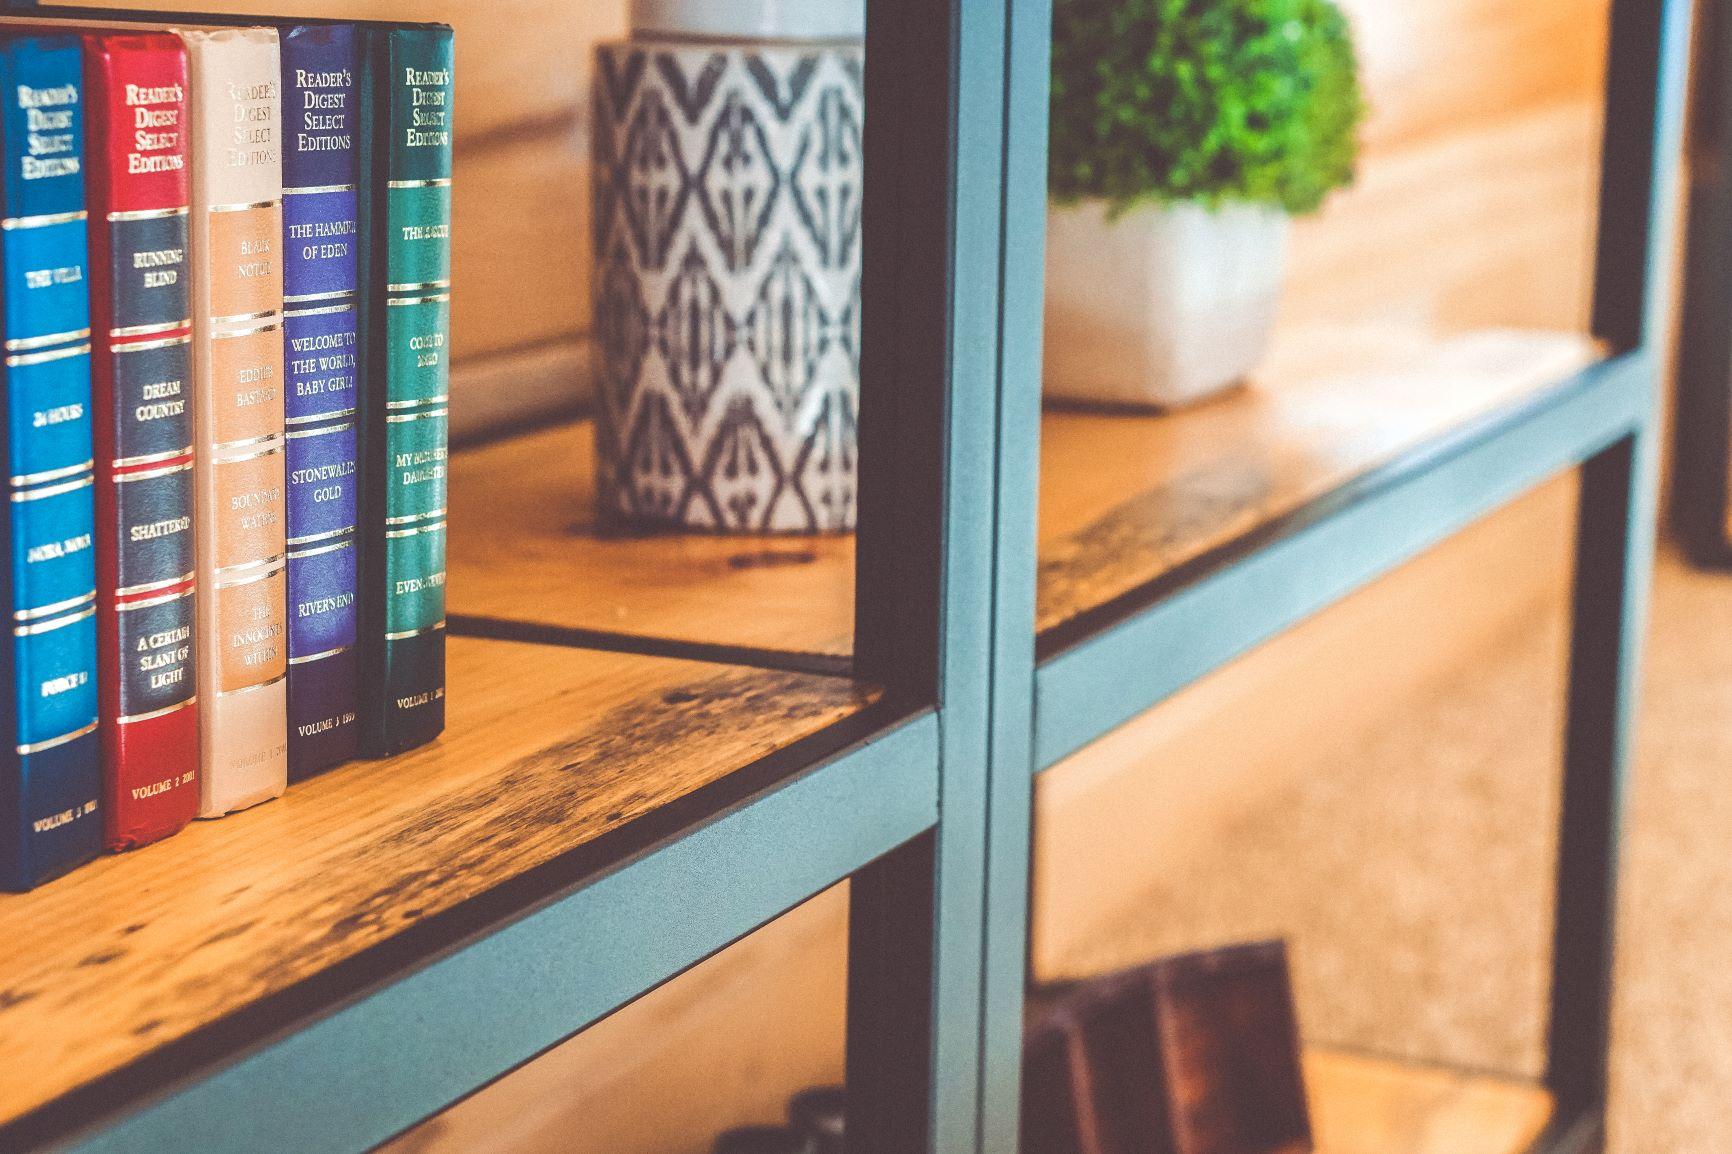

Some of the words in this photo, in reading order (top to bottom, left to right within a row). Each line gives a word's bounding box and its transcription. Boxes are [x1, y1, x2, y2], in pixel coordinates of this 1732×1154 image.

[296, 69, 351, 88] READER'S
[303, 91, 346, 109] DIGEST
[412, 88, 446, 106] DIGEST
[135, 107, 179, 128] DIGEST
[304, 112, 345, 130] SELECT
[135, 130, 179, 150] SELECT
[297, 134, 350, 151] EDITIONS
[406, 129, 449, 147] EDITIONS
[128, 153, 184, 174] EDITIONS
[289, 224, 313, 239] THE
[402, 226, 423, 240] THE
[133, 249, 183, 268] RUNNING
[303, 246, 318, 260] OF
[321, 243, 348, 258] EDEN
[144, 270, 178, 288] BLIND
[291, 334, 343, 352] WELCOME
[344, 332, 356, 346] TO
[292, 359, 316, 374] THE
[143, 381, 181, 400] DREAM
[296, 380, 325, 396] BABY
[136, 400, 185, 421] COUNTRY
[396, 453, 412, 468] MY
[314, 486, 341, 502] GOLD
[137, 637, 147, 651] A
[140, 651, 178, 671] SLANT
[151, 668, 183, 689] LIGHT
[298, 718, 333, 737] VOLUME
[132, 779, 171, 800] VOLUME
